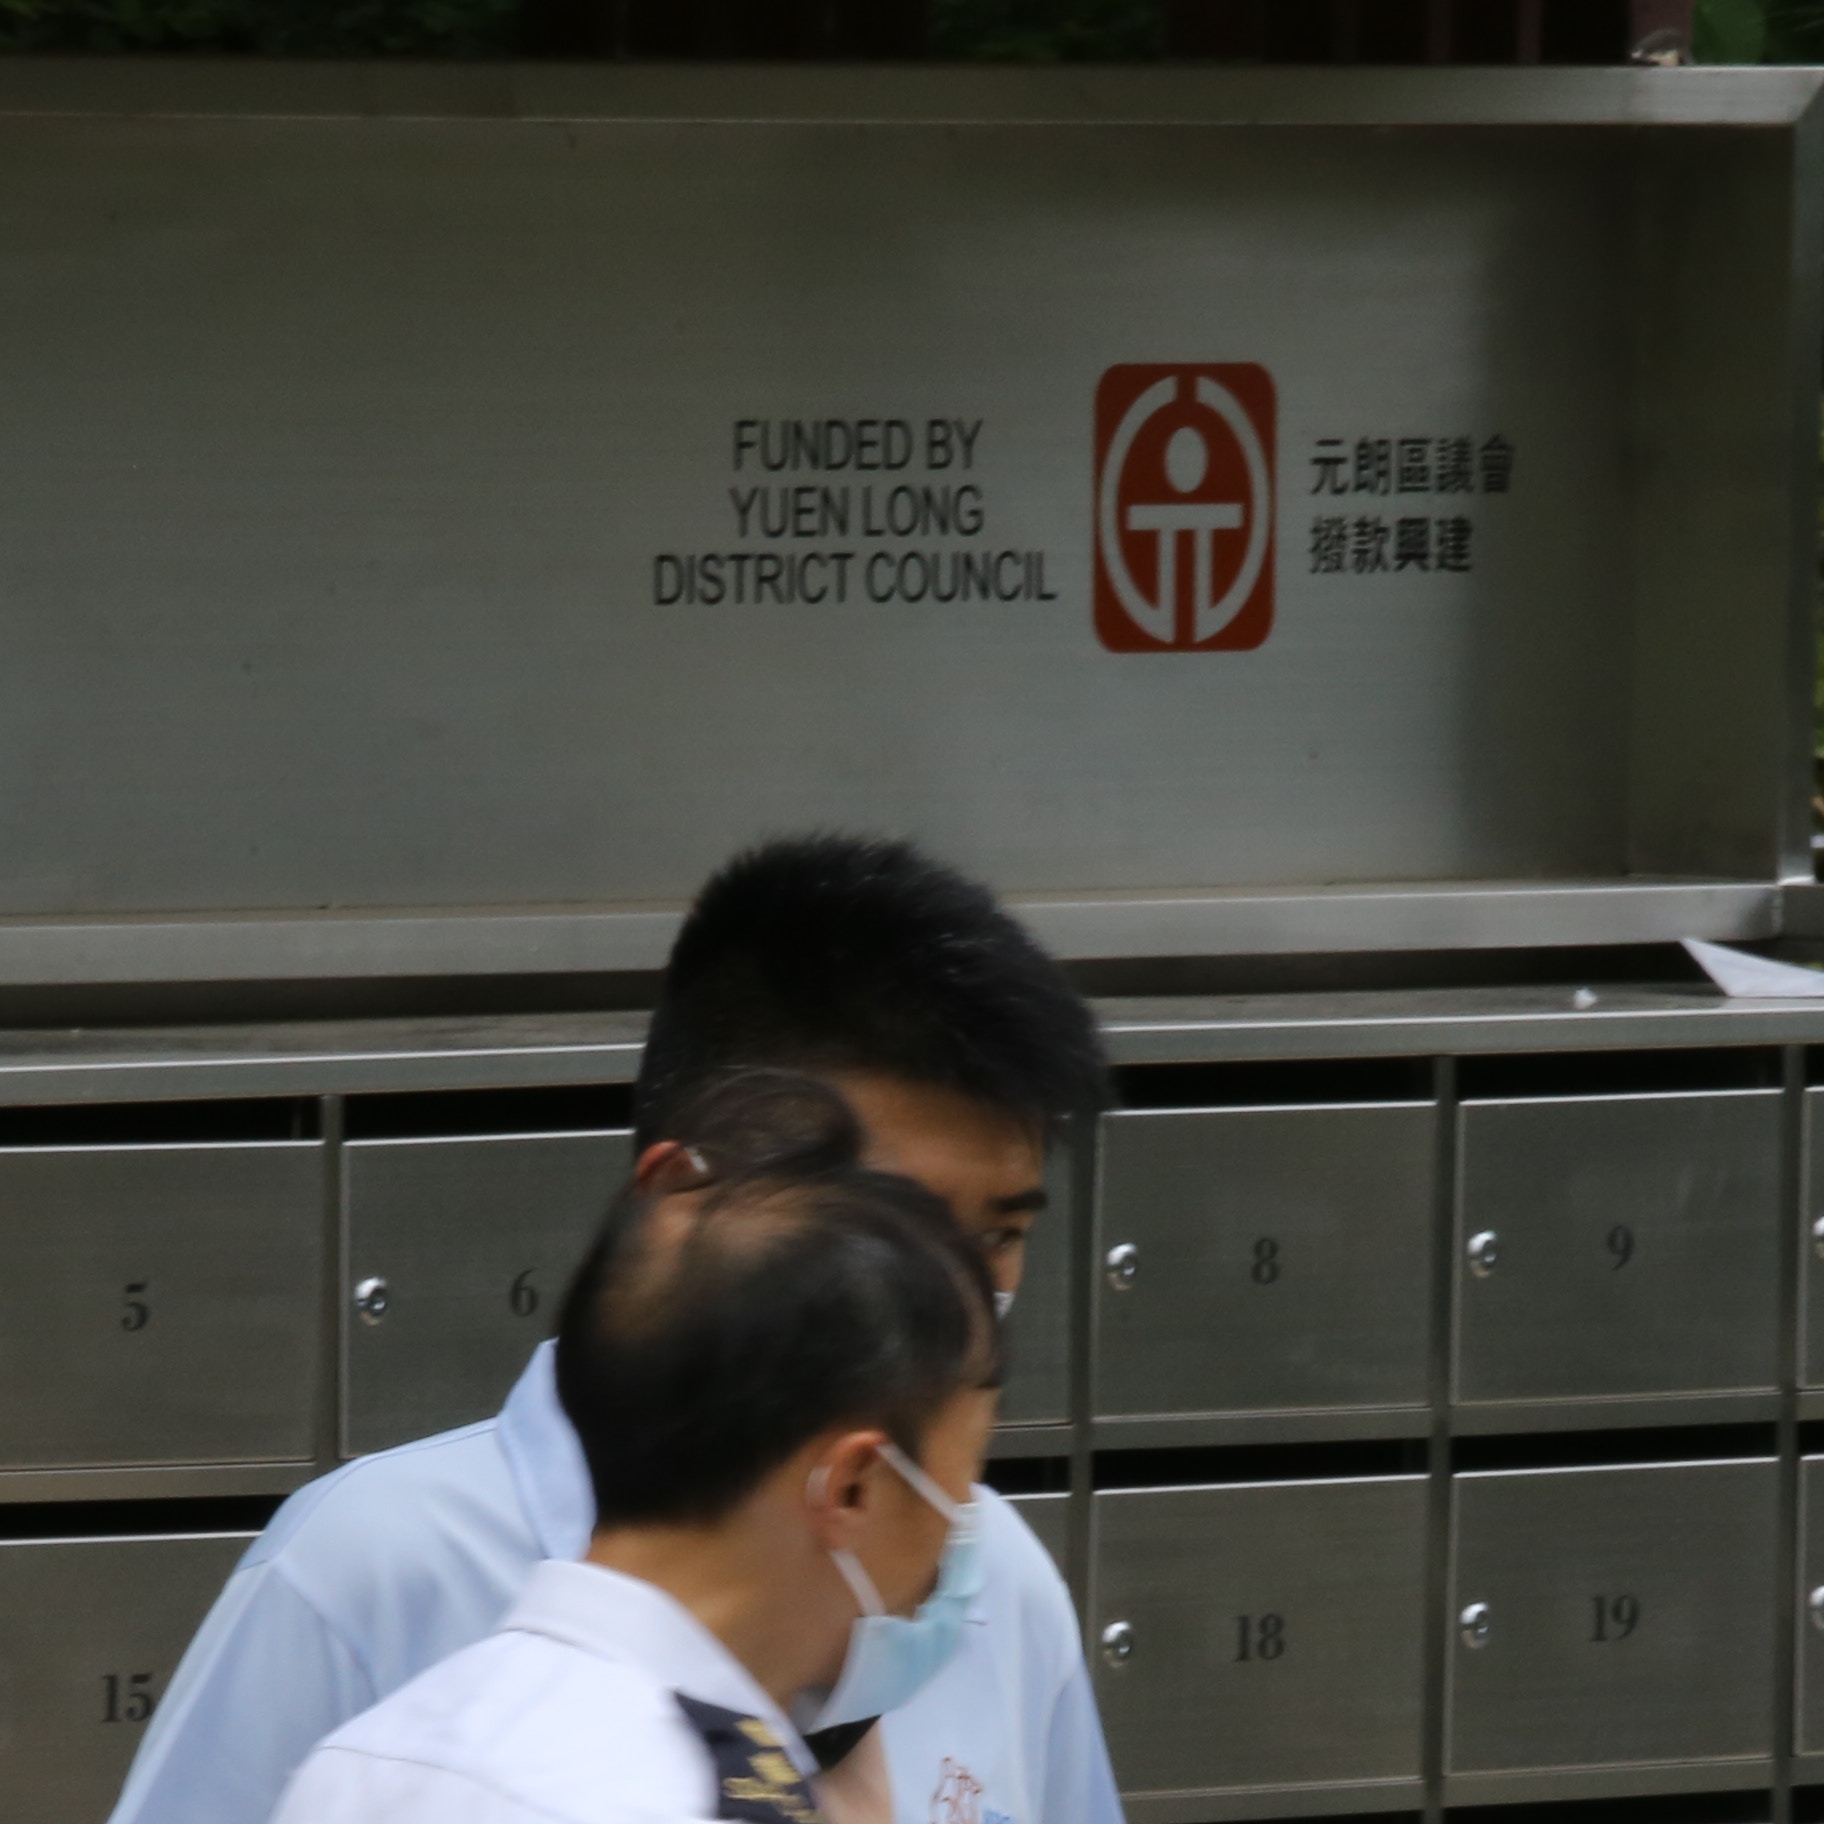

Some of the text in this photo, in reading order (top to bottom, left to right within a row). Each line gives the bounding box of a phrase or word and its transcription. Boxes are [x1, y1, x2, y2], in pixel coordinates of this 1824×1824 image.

[732, 418, 984, 472] FUNDED BY
[1309, 434, 1517, 496] 元朗區議會
[727, 483, 985, 538] YUEN LONG
[1308, 514, 1474, 575] 撥款興建
[653, 549, 1059, 605] DISTRICT COUNCIL
[1251, 1237, 1281, 1285] 8
[1606, 1225, 1635, 1271] 9
[121, 1282, 150, 1332] 5
[509, 1269, 539, 1316] 6
[1235, 1613, 1286, 1662] 18
[1591, 1595, 1640, 1642] 19
[102, 1672, 155, 1723] 15
